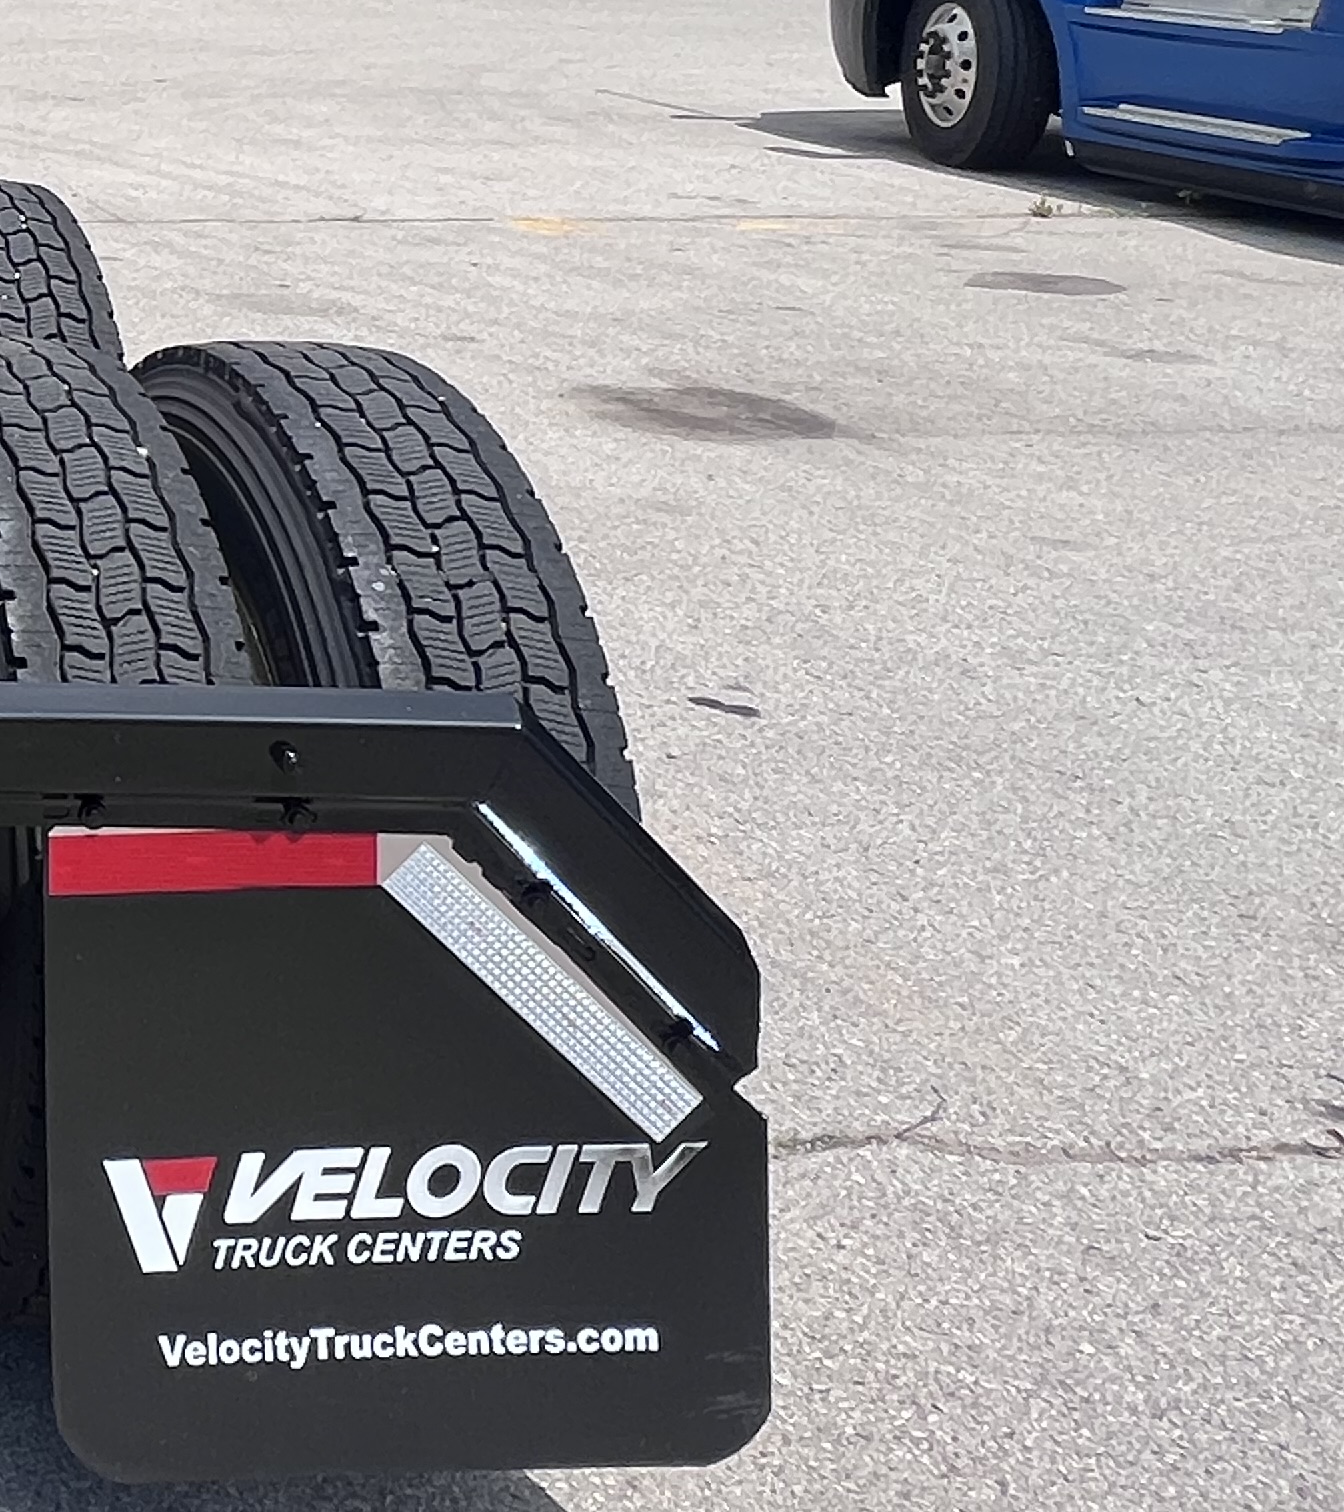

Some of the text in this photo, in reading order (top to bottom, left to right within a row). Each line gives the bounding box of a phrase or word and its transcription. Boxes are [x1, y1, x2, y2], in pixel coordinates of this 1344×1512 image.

[223, 1140, 709, 1224] VELOCITY
[212, 1229, 523, 1270] TRUCK CENTERS
[157, 1321, 660, 1370] VelocityTruckCenters.com
